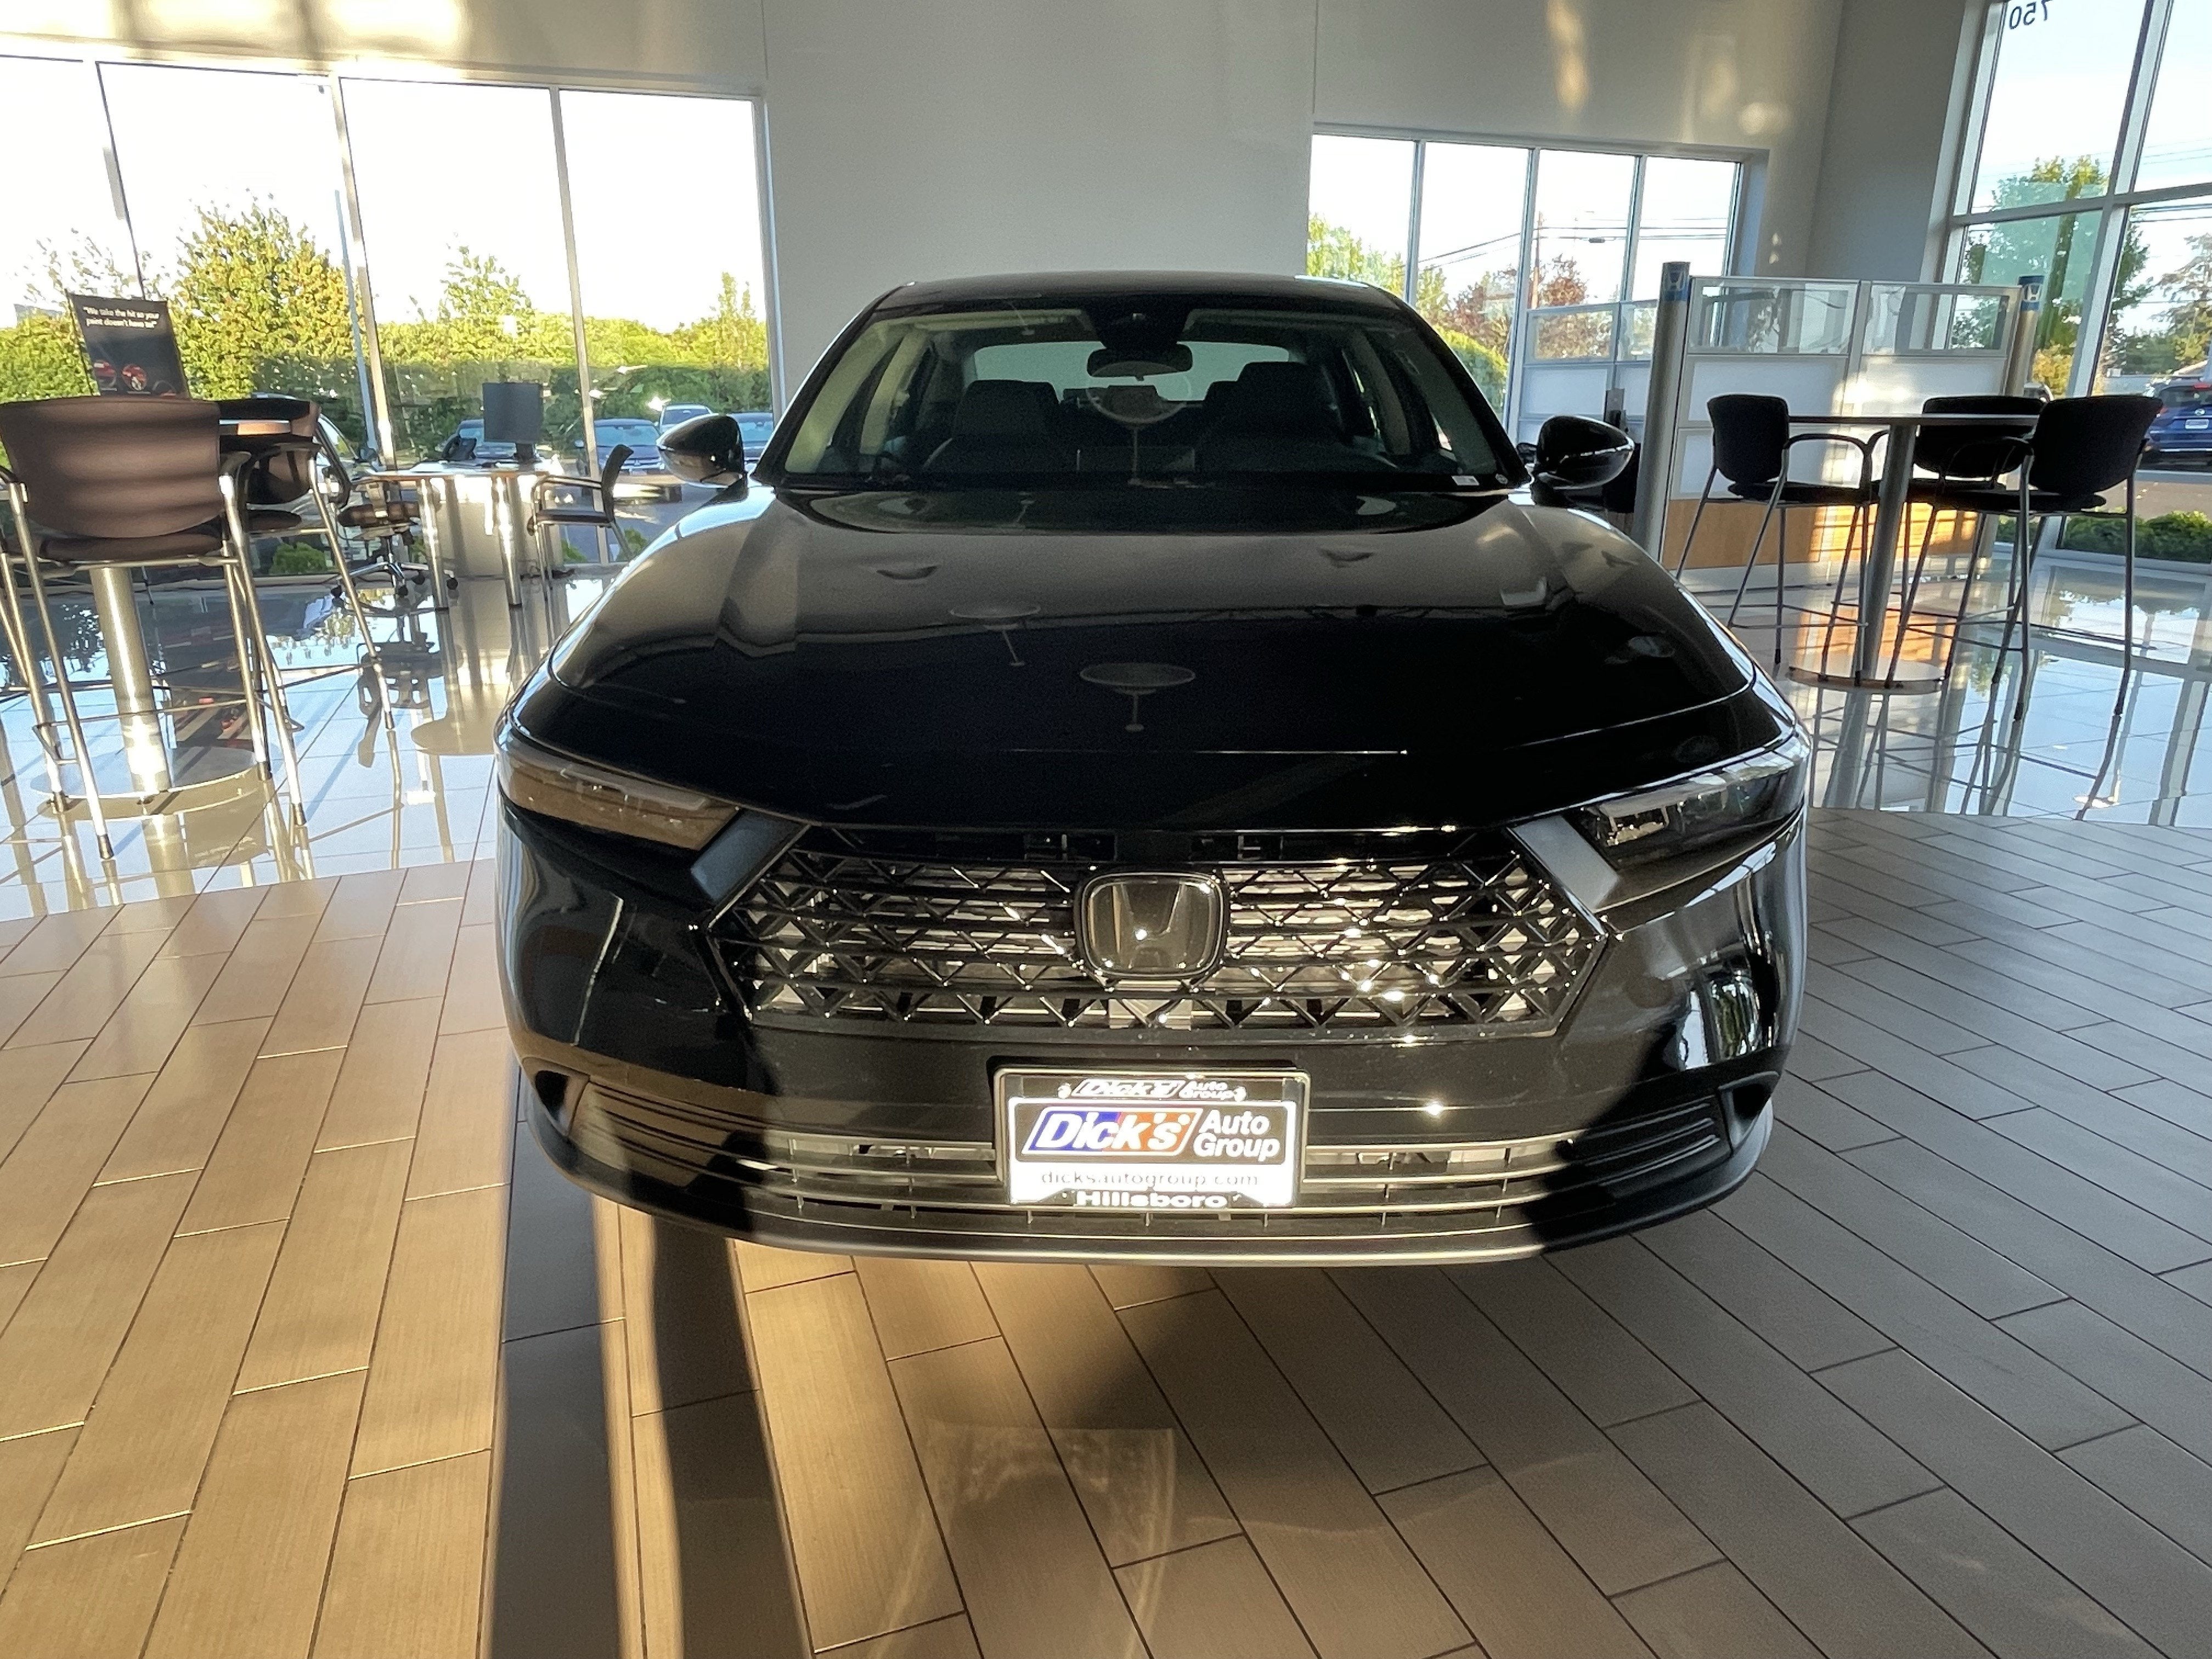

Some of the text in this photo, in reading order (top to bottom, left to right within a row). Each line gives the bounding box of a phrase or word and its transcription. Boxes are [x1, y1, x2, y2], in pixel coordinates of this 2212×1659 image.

[1036, 1109, 1270, 1150] Dick's Auto
[1193, 1133, 1280, 1161] Group
[1042, 1171, 1259, 1188] dicksautogroupcom
[1076, 1189, 1228, 1207] Hillsboro
